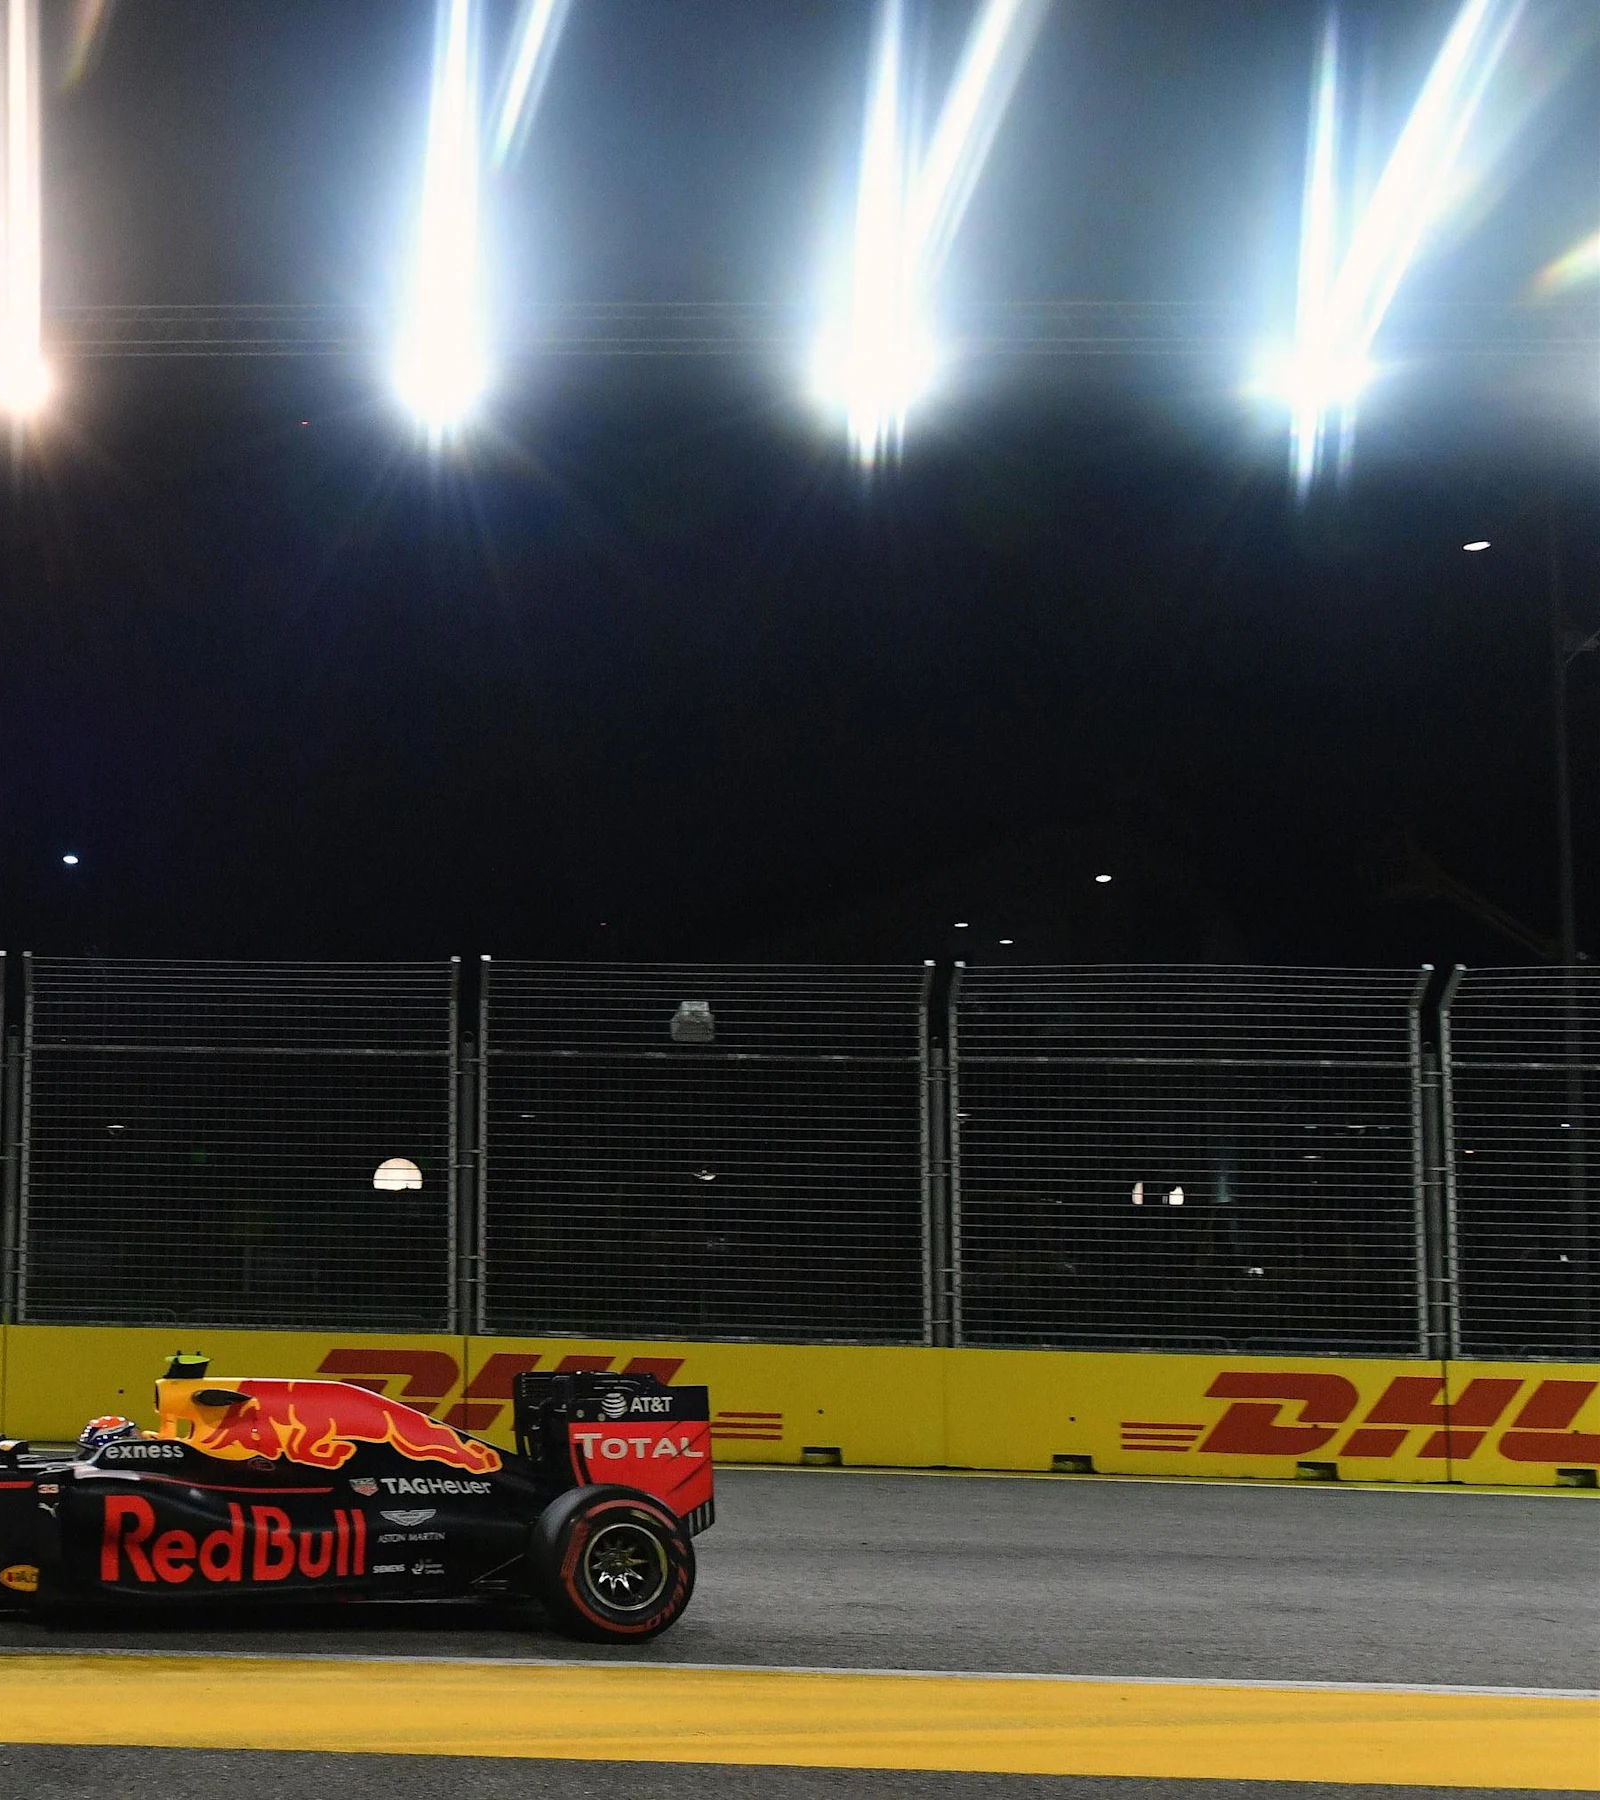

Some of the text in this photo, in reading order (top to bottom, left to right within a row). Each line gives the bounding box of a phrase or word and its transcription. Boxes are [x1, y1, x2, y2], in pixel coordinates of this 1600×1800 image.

[629, 1396, 673, 1413] AT&T
[1198, 1371, 1600, 1464] DHL
[105, 1444, 185, 1459] exness
[573, 1432, 704, 1460] TOTAL
